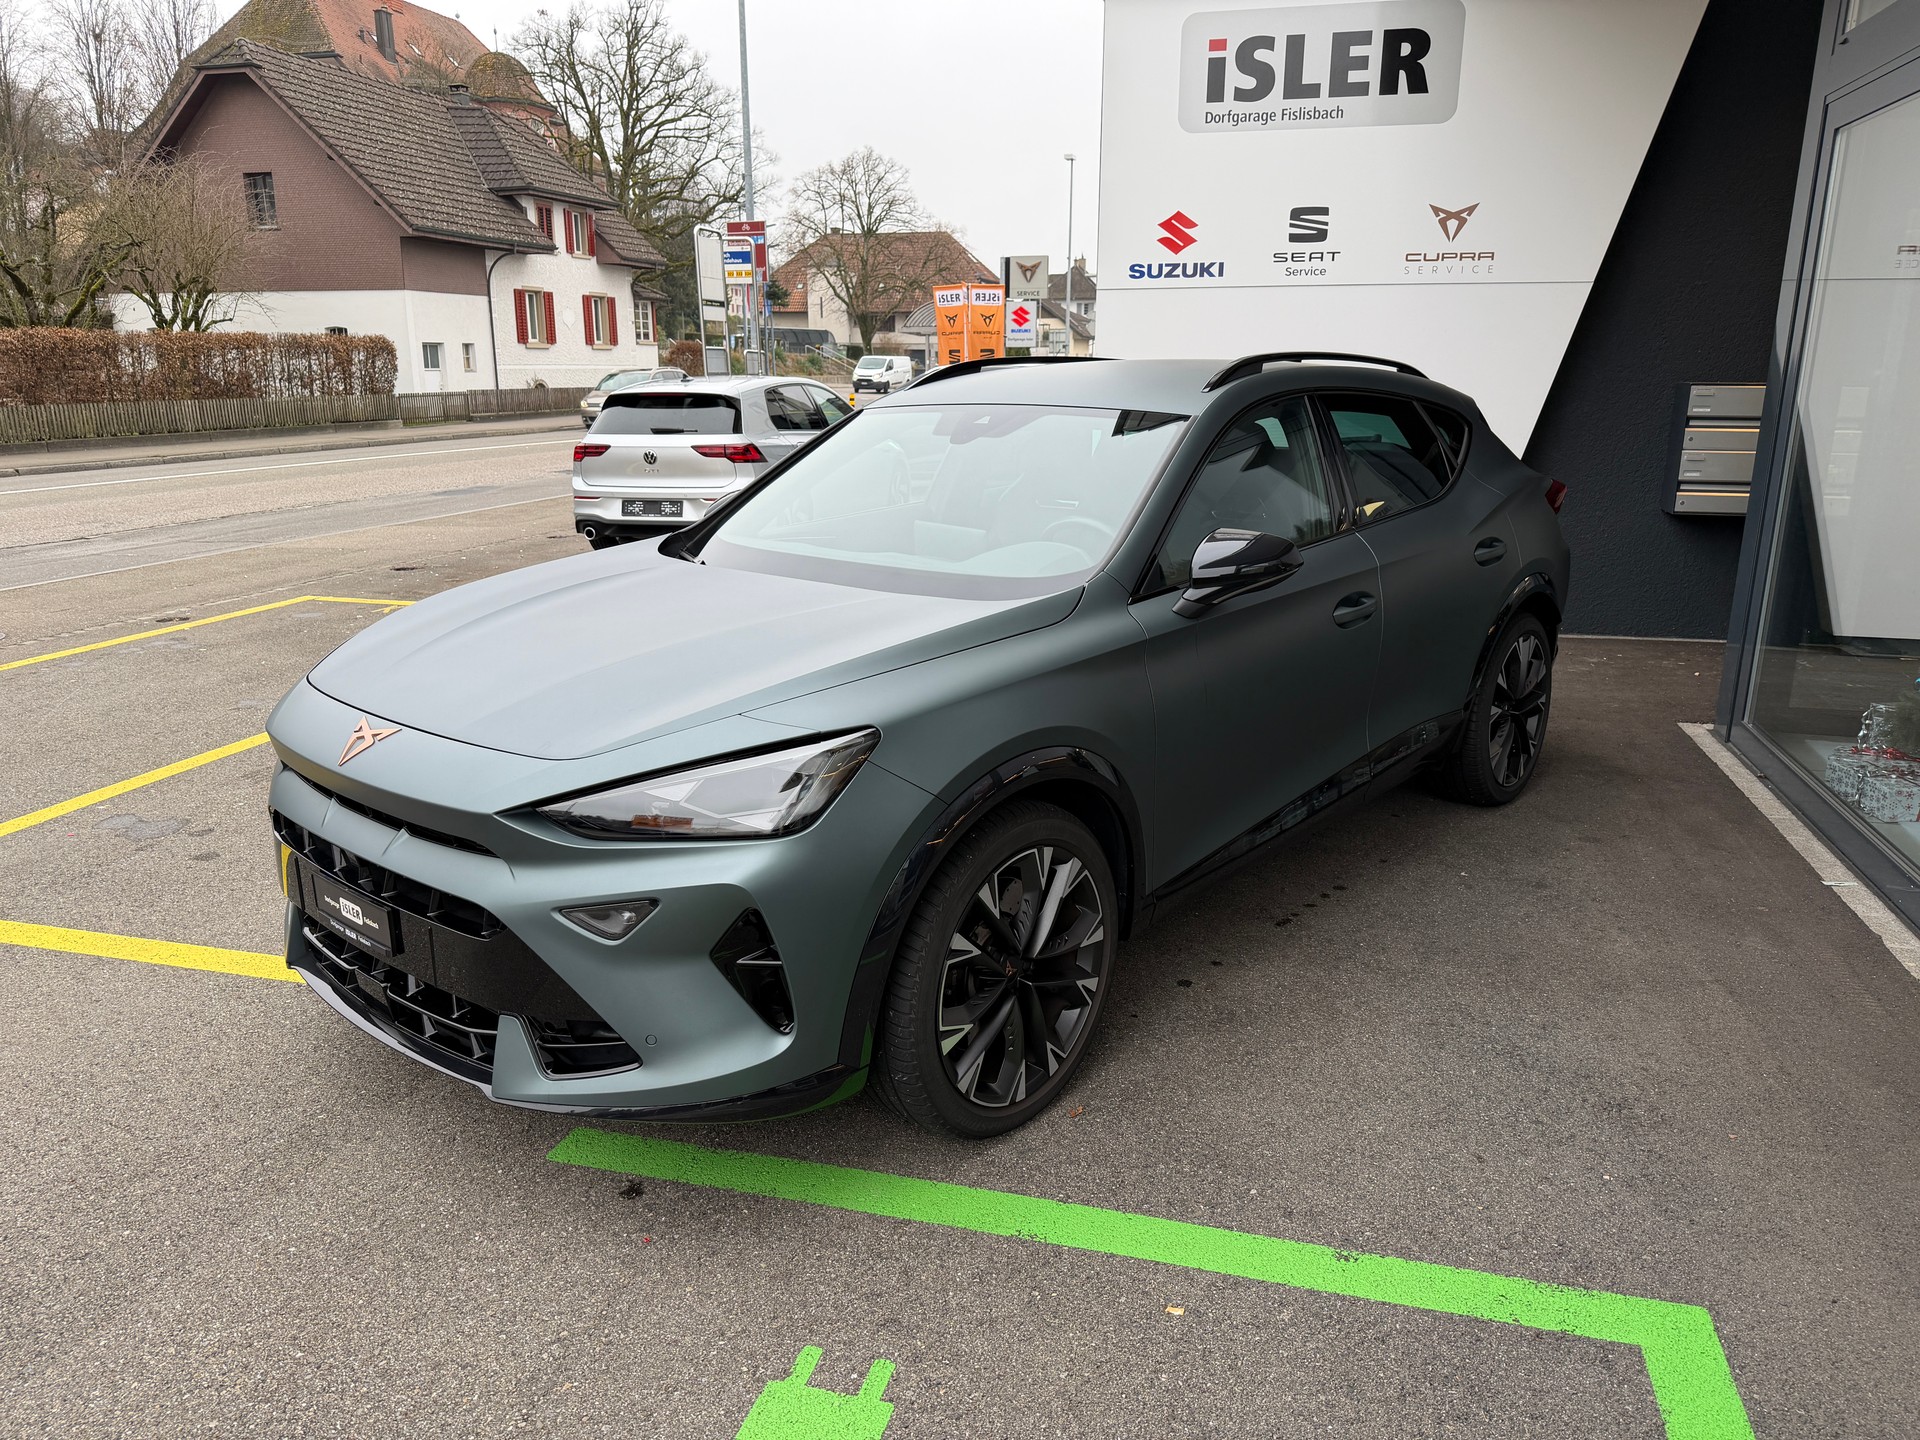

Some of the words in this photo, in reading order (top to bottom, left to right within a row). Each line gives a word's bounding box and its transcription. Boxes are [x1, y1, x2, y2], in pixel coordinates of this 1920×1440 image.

[1206, 27, 1432, 104] iSLER
[1204, 109, 1277, 127] Dorfgarage
[1281, 105, 1344, 122] Fislisbach
[1272, 251, 1342, 263] SEAT
[1405, 252, 1495, 262] CUPRA
[1128, 261, 1225, 279] SUZUKI
[1284, 265, 1327, 277] Service
[1403, 264, 1494, 275] SERVICE
[938, 293, 961, 303] iSLER
